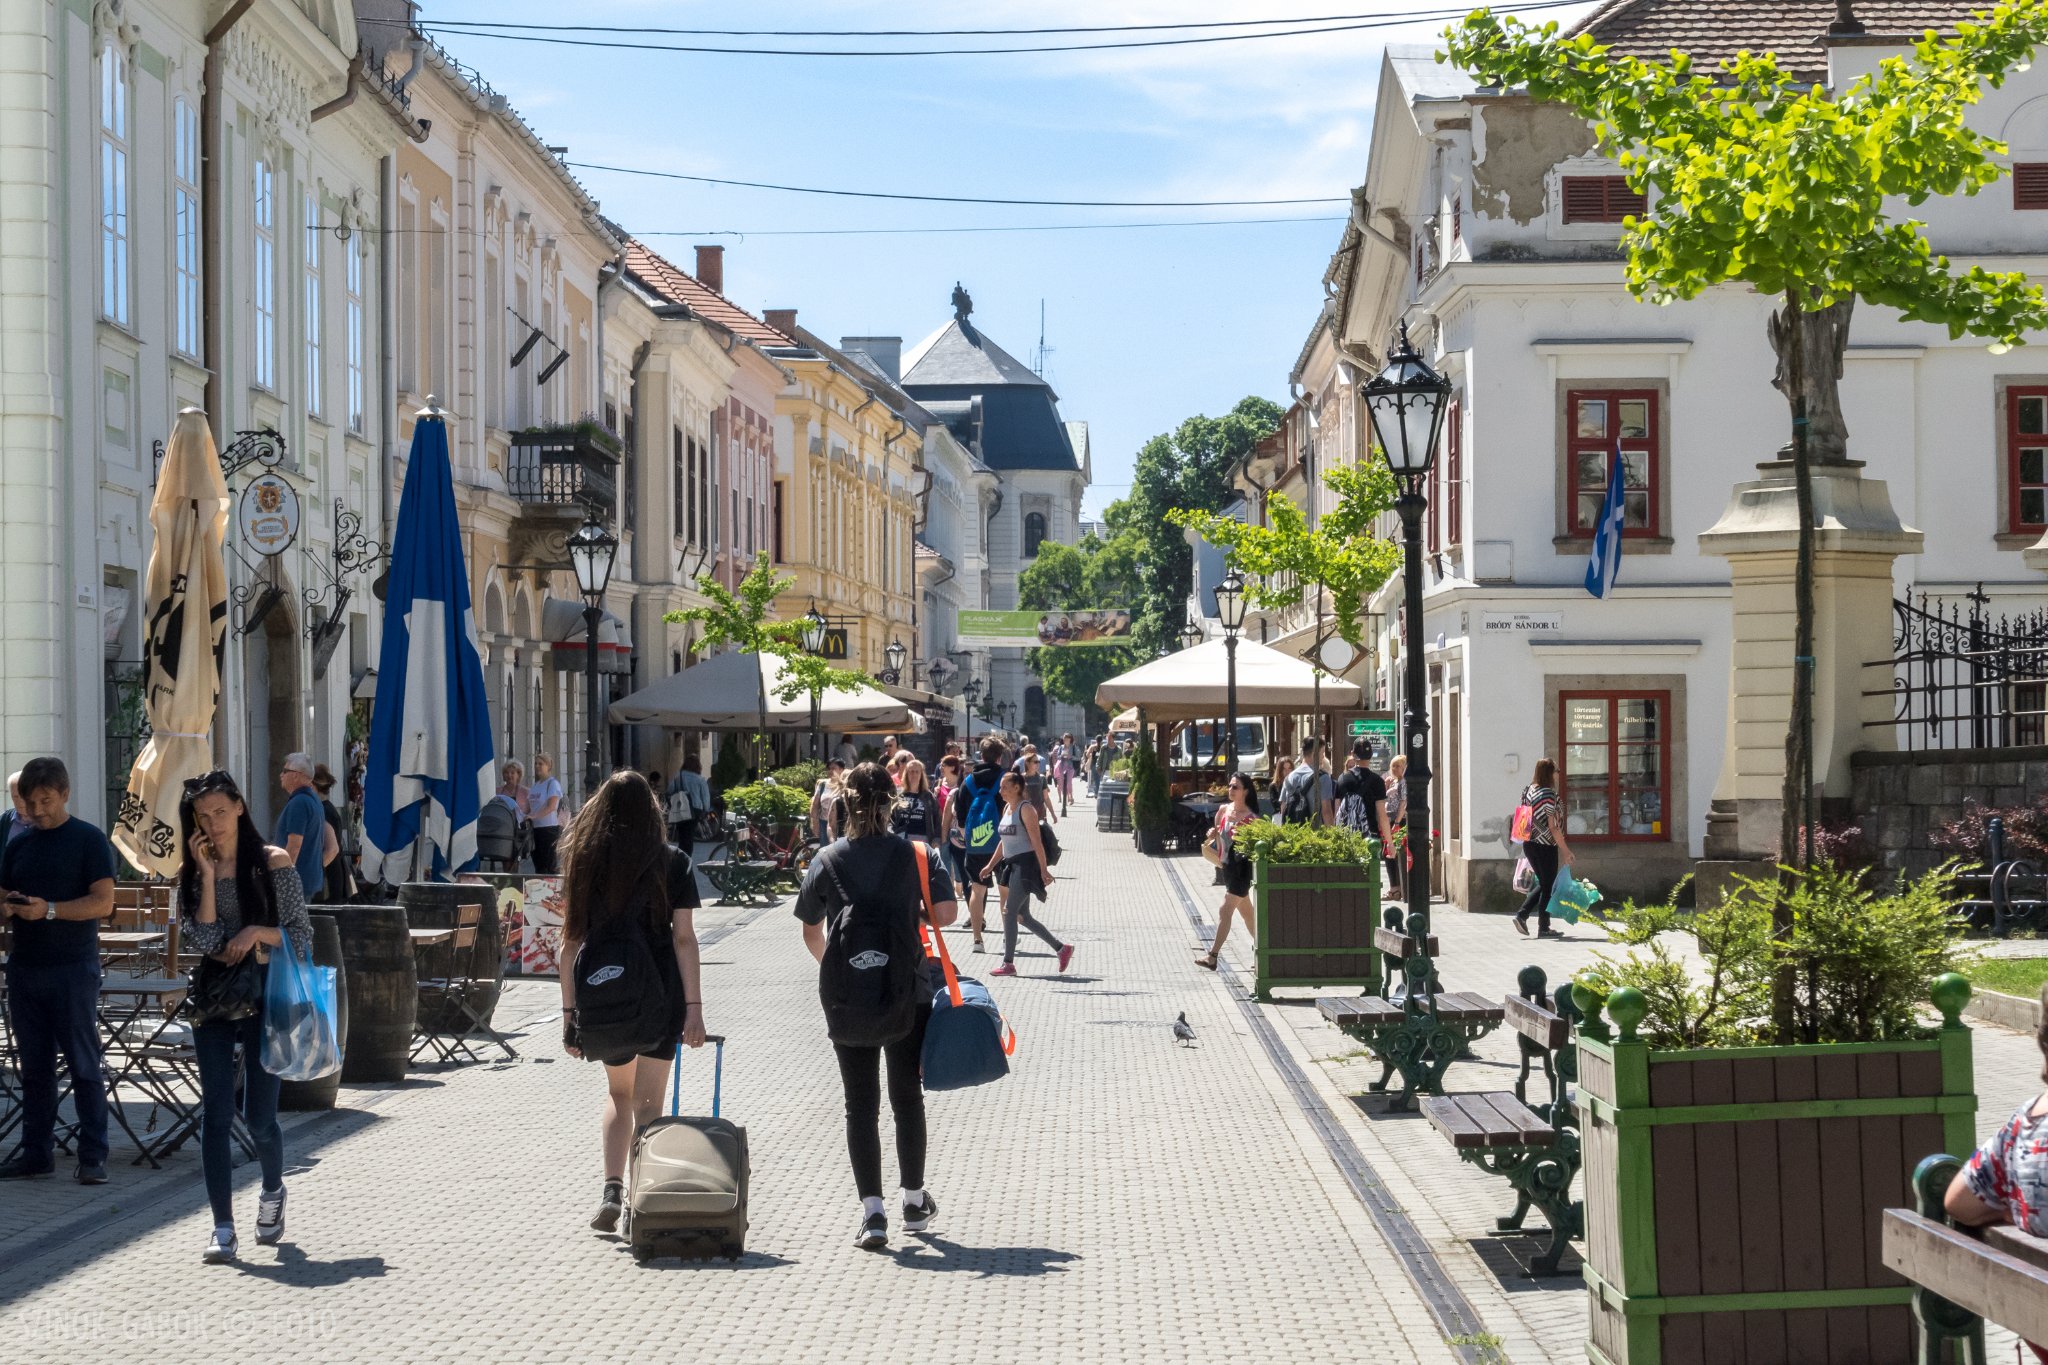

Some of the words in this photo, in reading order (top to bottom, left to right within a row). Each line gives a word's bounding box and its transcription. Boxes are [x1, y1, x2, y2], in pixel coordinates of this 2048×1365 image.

[1486, 620, 1512, 629] BRÓDY
[1515, 620, 1549, 629] SÁNDOR
[972, 819, 994, 841] NIKE
